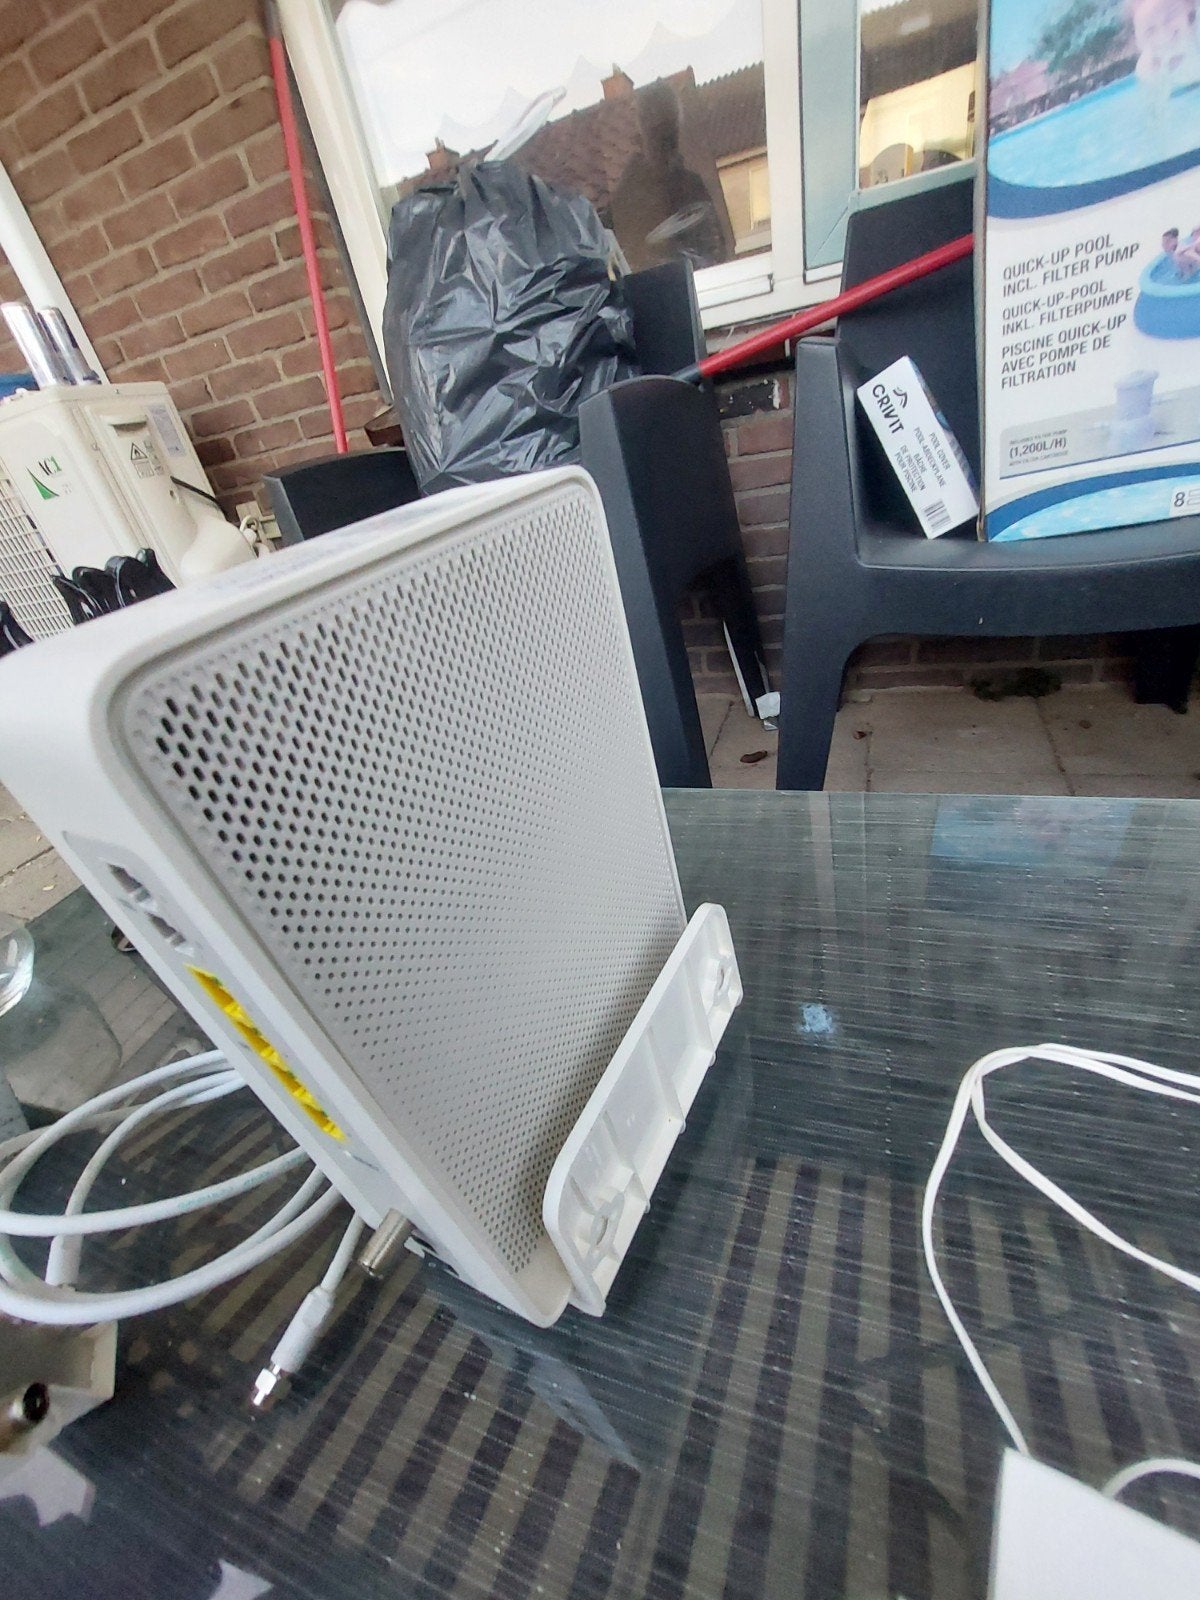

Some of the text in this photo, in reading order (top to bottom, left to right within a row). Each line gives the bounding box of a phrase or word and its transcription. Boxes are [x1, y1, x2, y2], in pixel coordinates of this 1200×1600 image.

[1003, 234, 1114, 280] QUICK-UP POOL
[1003, 243, 1140, 297] INCL. FILTER PUMP
[1002, 280, 1107, 320] QUICK-UP-POOL
[1002, 287, 1134, 336] INKL. FILTERPUMPE
[1001, 314, 1127, 359] PISCINE QUICK-UP
[1001, 334, 1111, 374] AVEC POMPE DE
[1001, 360, 1076, 389] FILTRATION
[872, 384, 904, 434] CRIVIT
[1174, 492, 1186, 507] 8
